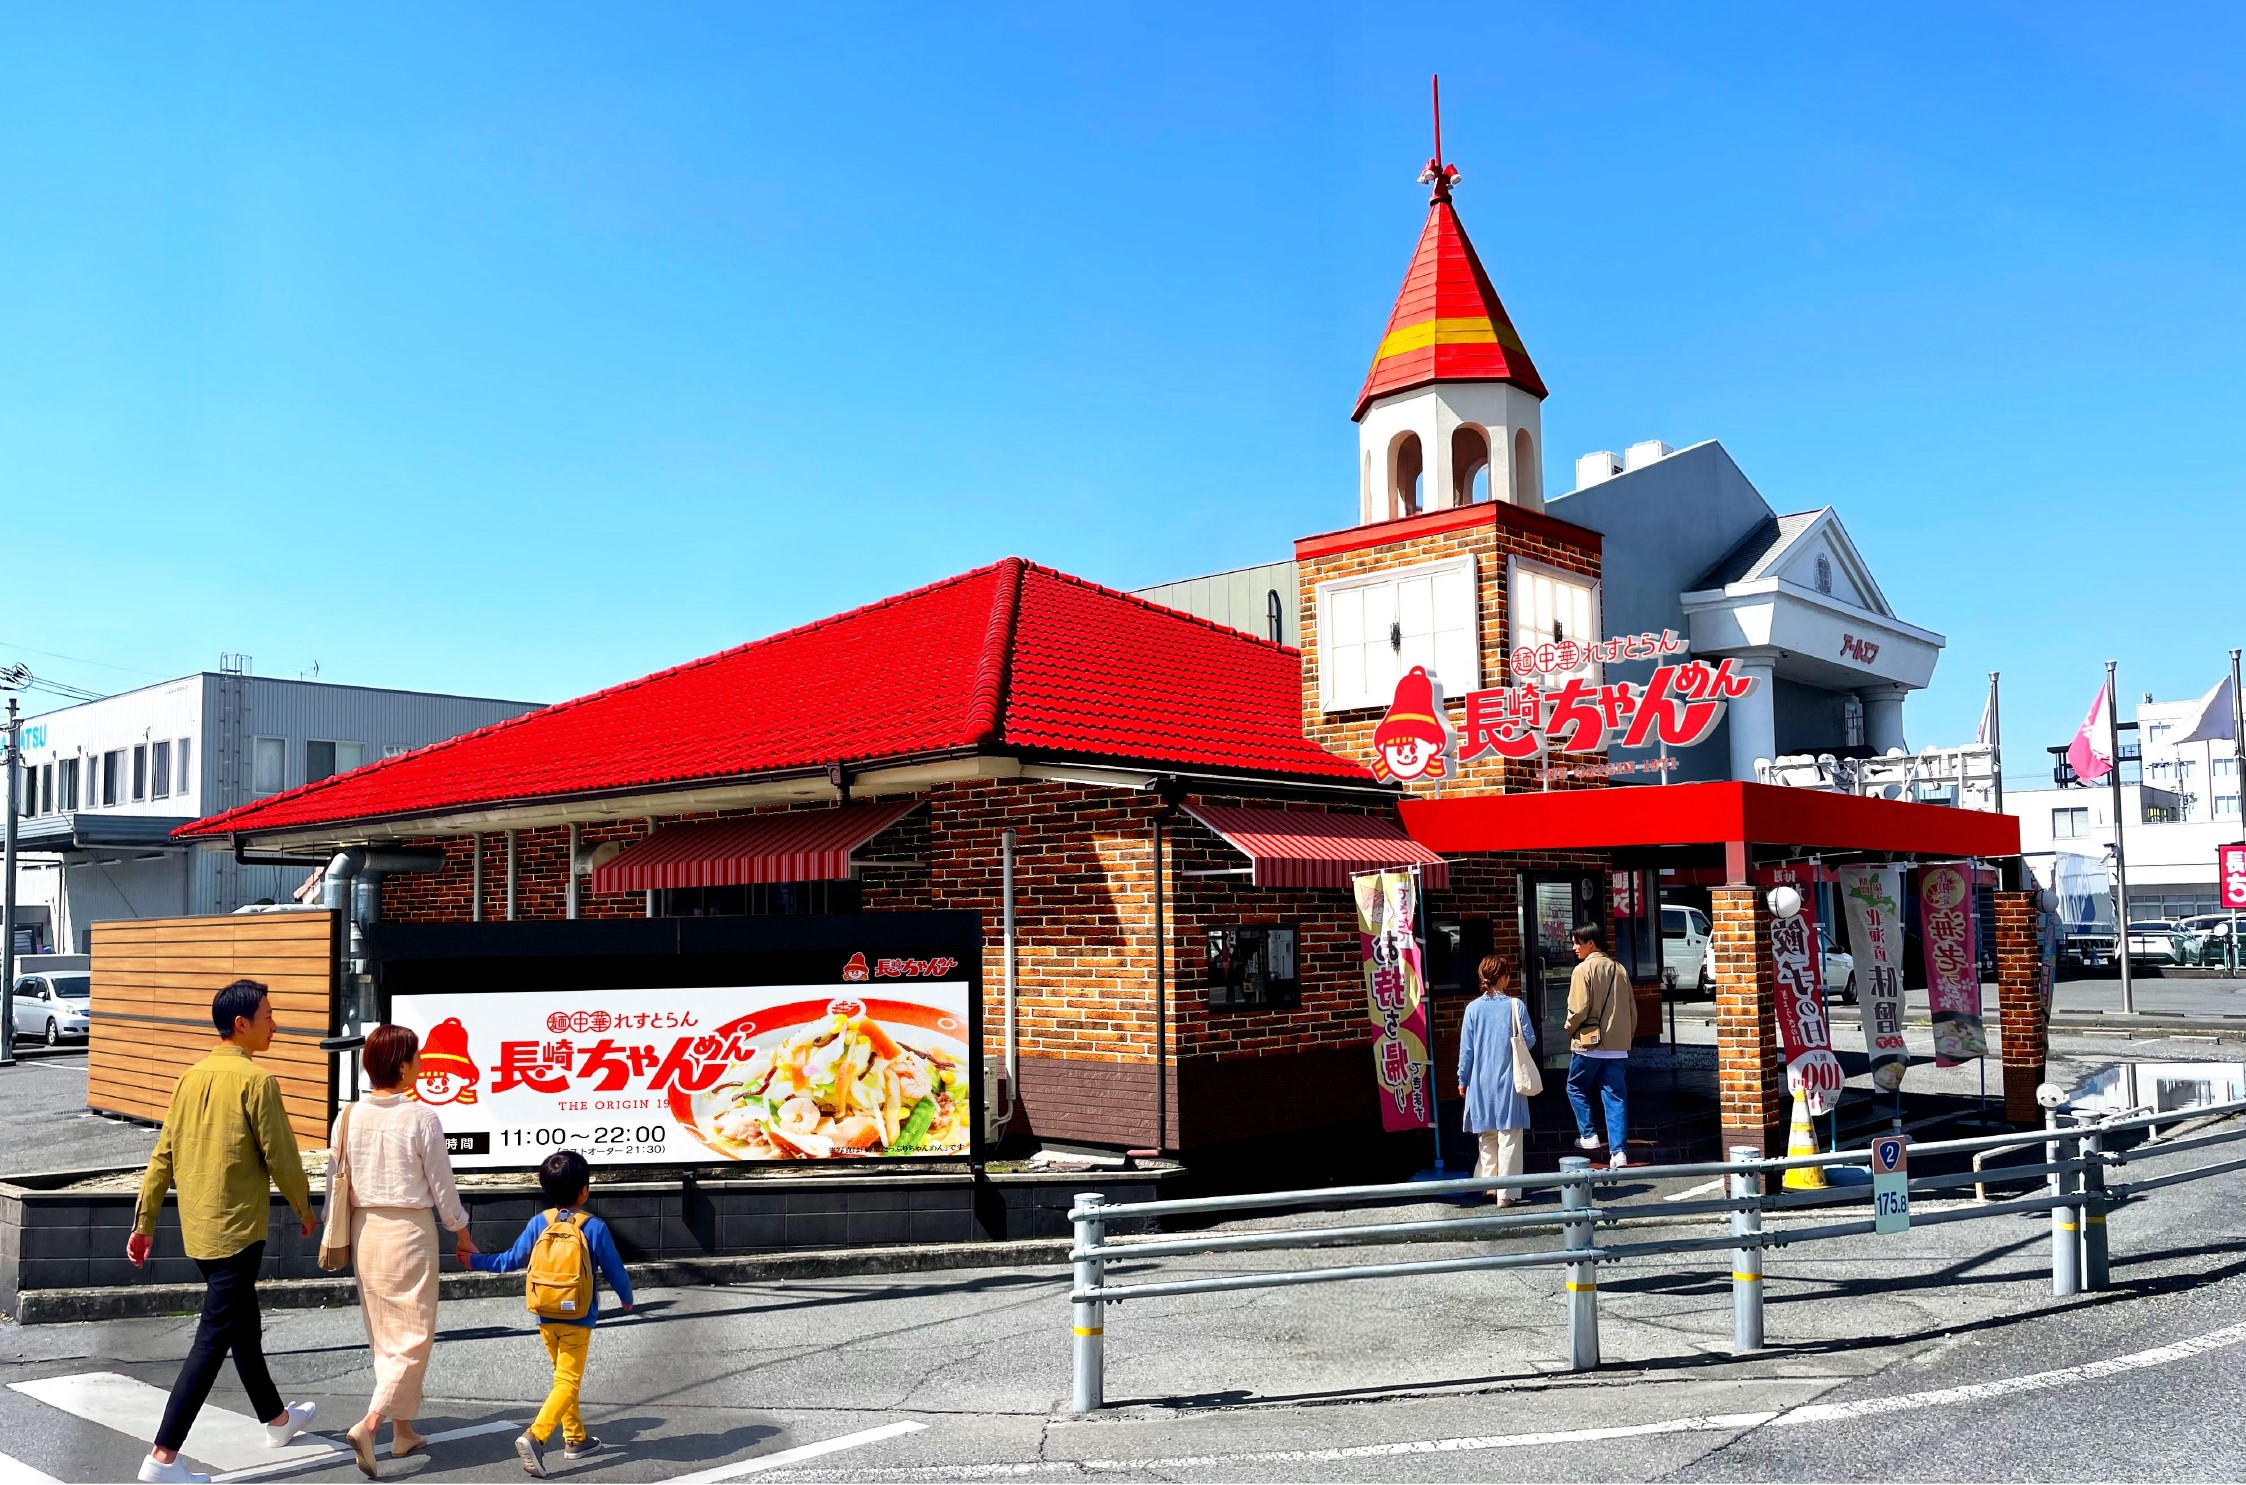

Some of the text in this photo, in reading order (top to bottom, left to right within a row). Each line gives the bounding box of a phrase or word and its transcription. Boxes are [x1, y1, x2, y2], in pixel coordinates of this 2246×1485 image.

[1840, 634, 1879, 664] アールエフ
[1457, 658, 1754, 761] 長崎ちゃんめん
[1535, 757, 1679, 782] THE ORIGIN 1971
[490, 1035, 756, 1094] 長崎ちゃんめん
[558, 1101, 588, 1111] THE
[595, 1099, 650, 1110] ORIGIN
[1886, 1145, 1894, 1163] 2
[1877, 1191, 1907, 1216] 175.8
